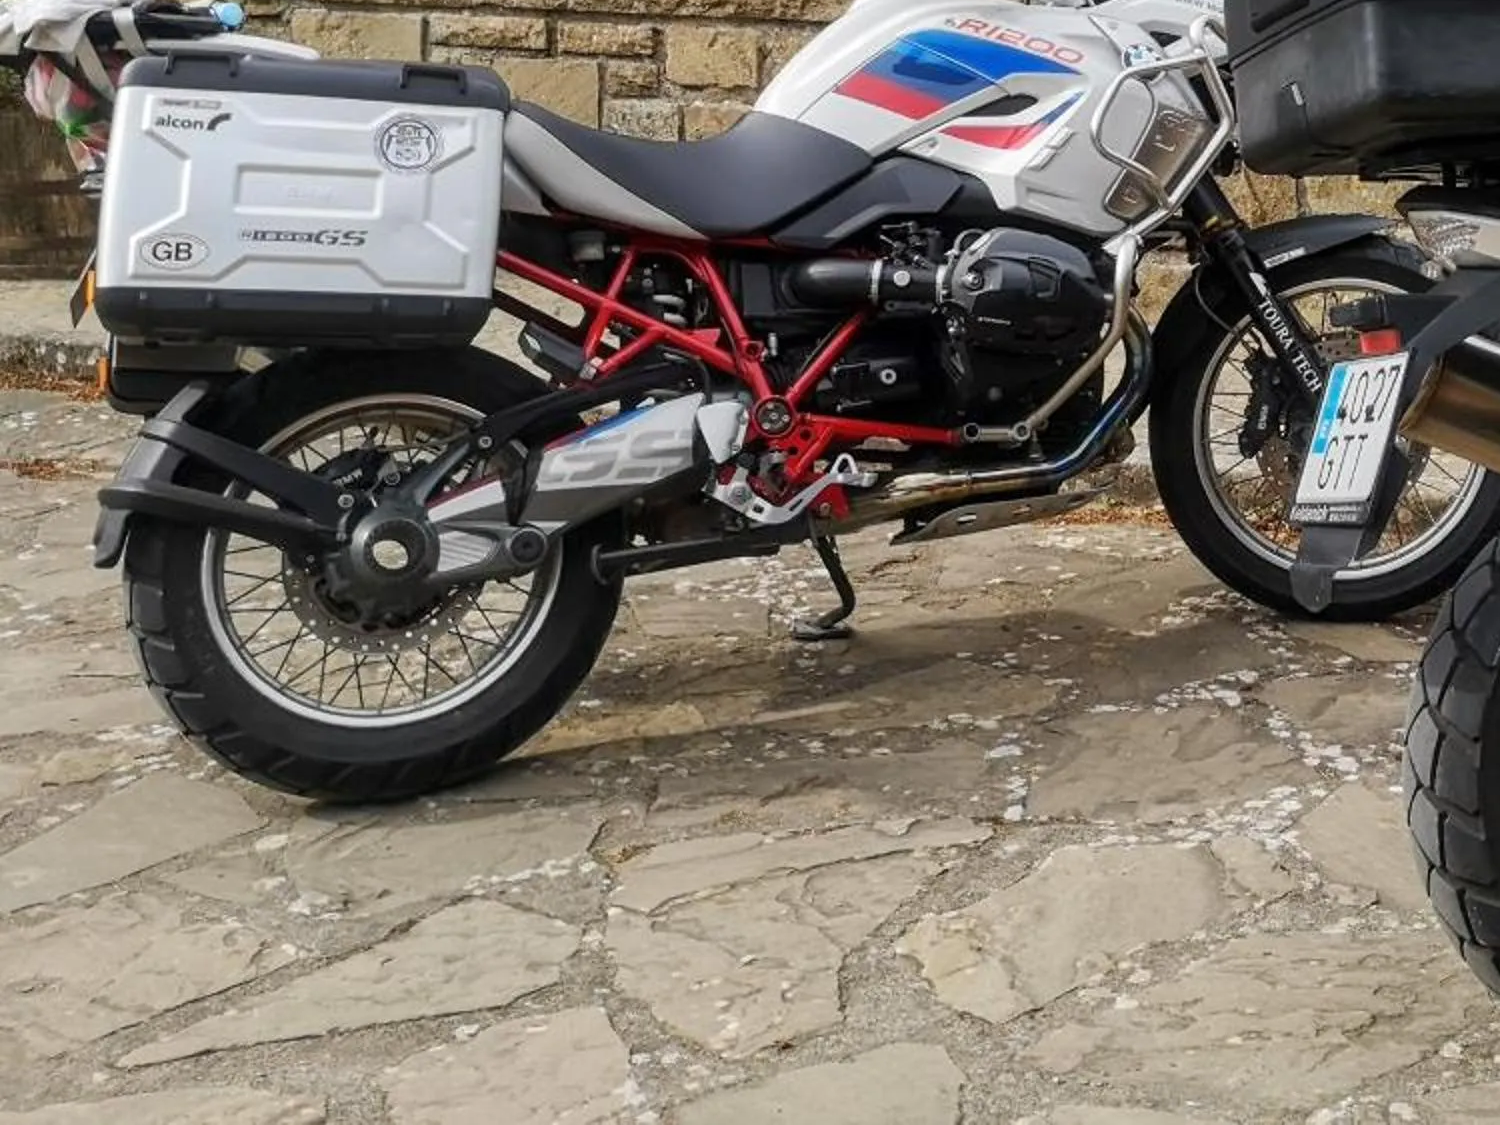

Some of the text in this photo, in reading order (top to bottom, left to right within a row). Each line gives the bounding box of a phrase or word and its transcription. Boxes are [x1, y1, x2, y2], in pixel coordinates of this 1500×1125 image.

[956, 18, 1085, 64] R1200
[155, 114, 205, 130] alcon
[151, 241, 193, 263] GB
[1337, 364, 1402, 425] 4027
[1317, 433, 1368, 491] GTT
